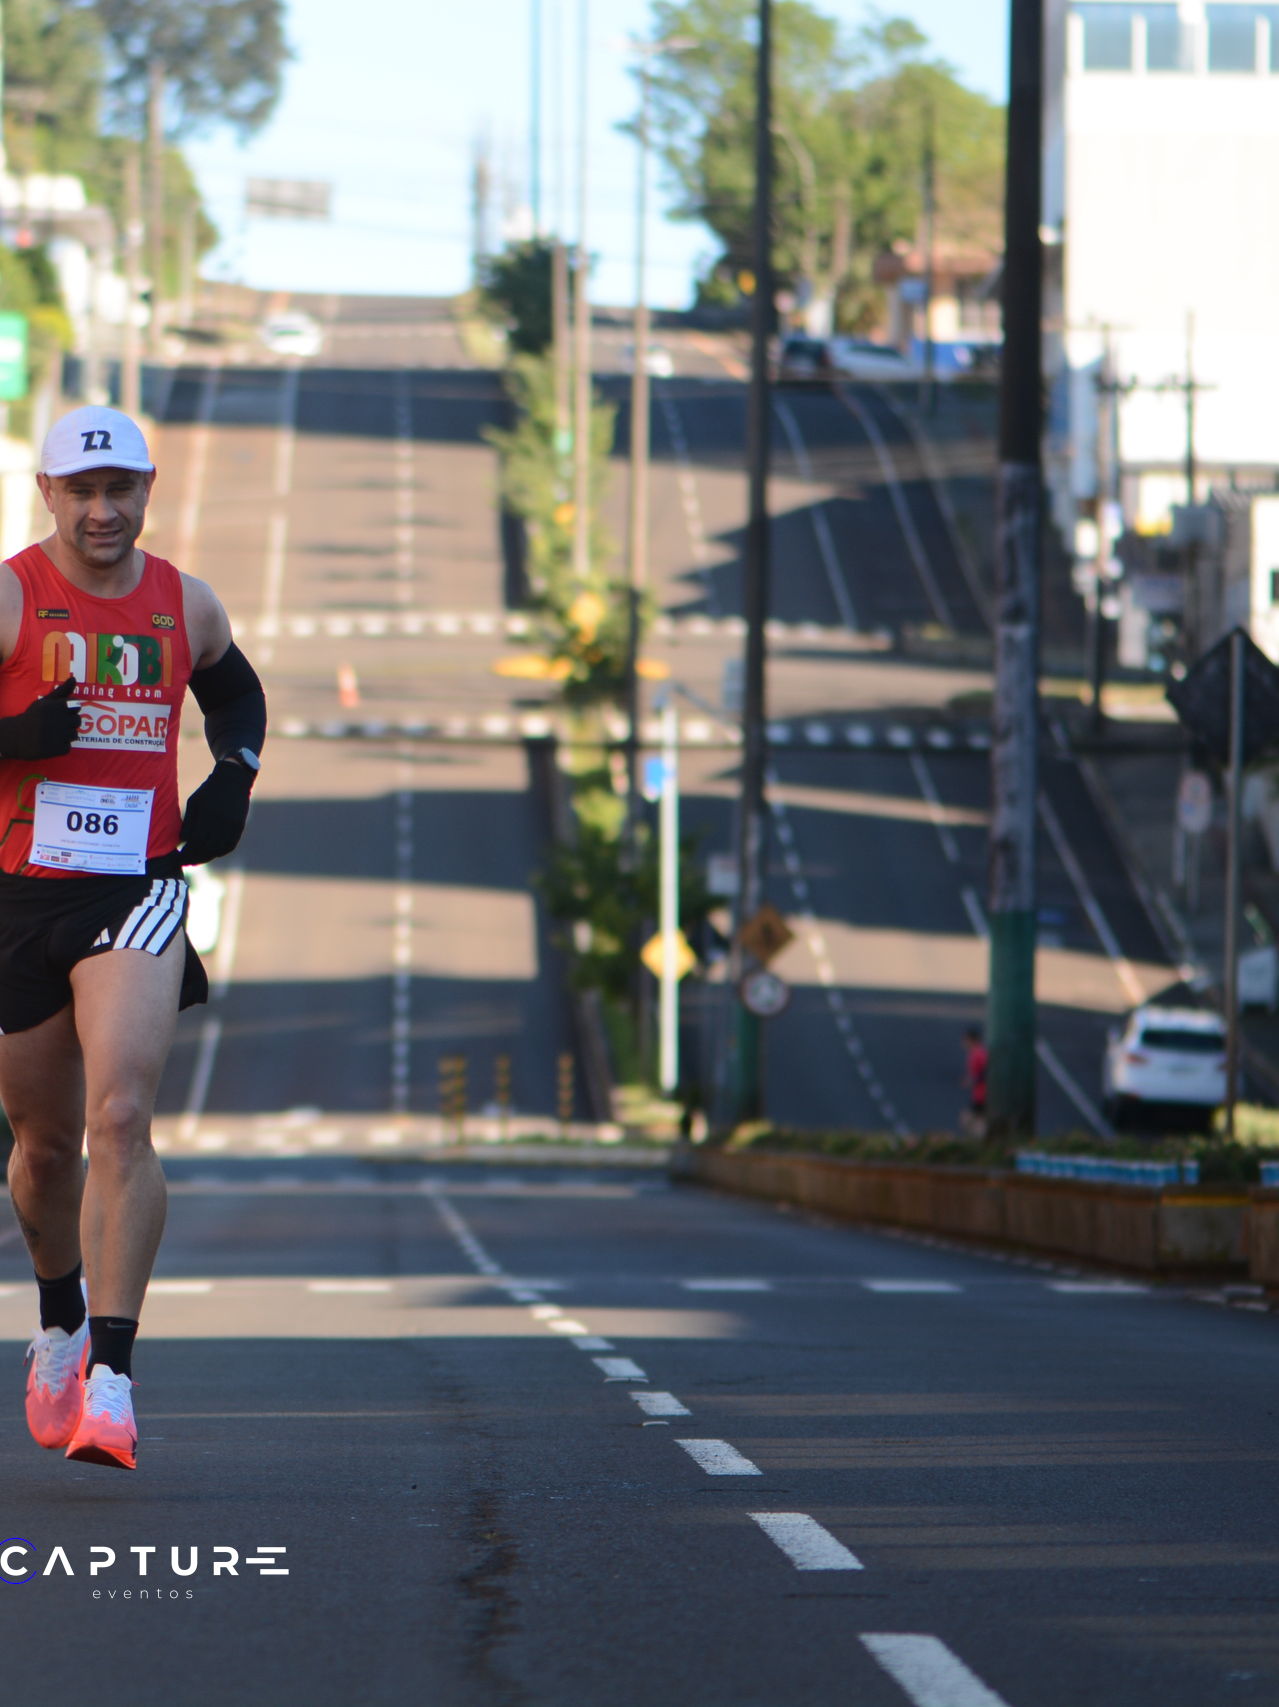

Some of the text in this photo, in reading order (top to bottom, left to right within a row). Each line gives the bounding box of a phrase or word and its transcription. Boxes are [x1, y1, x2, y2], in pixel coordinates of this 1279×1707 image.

[55, 685, 162, 698] nning team
[66, 811, 119, 835] 086
